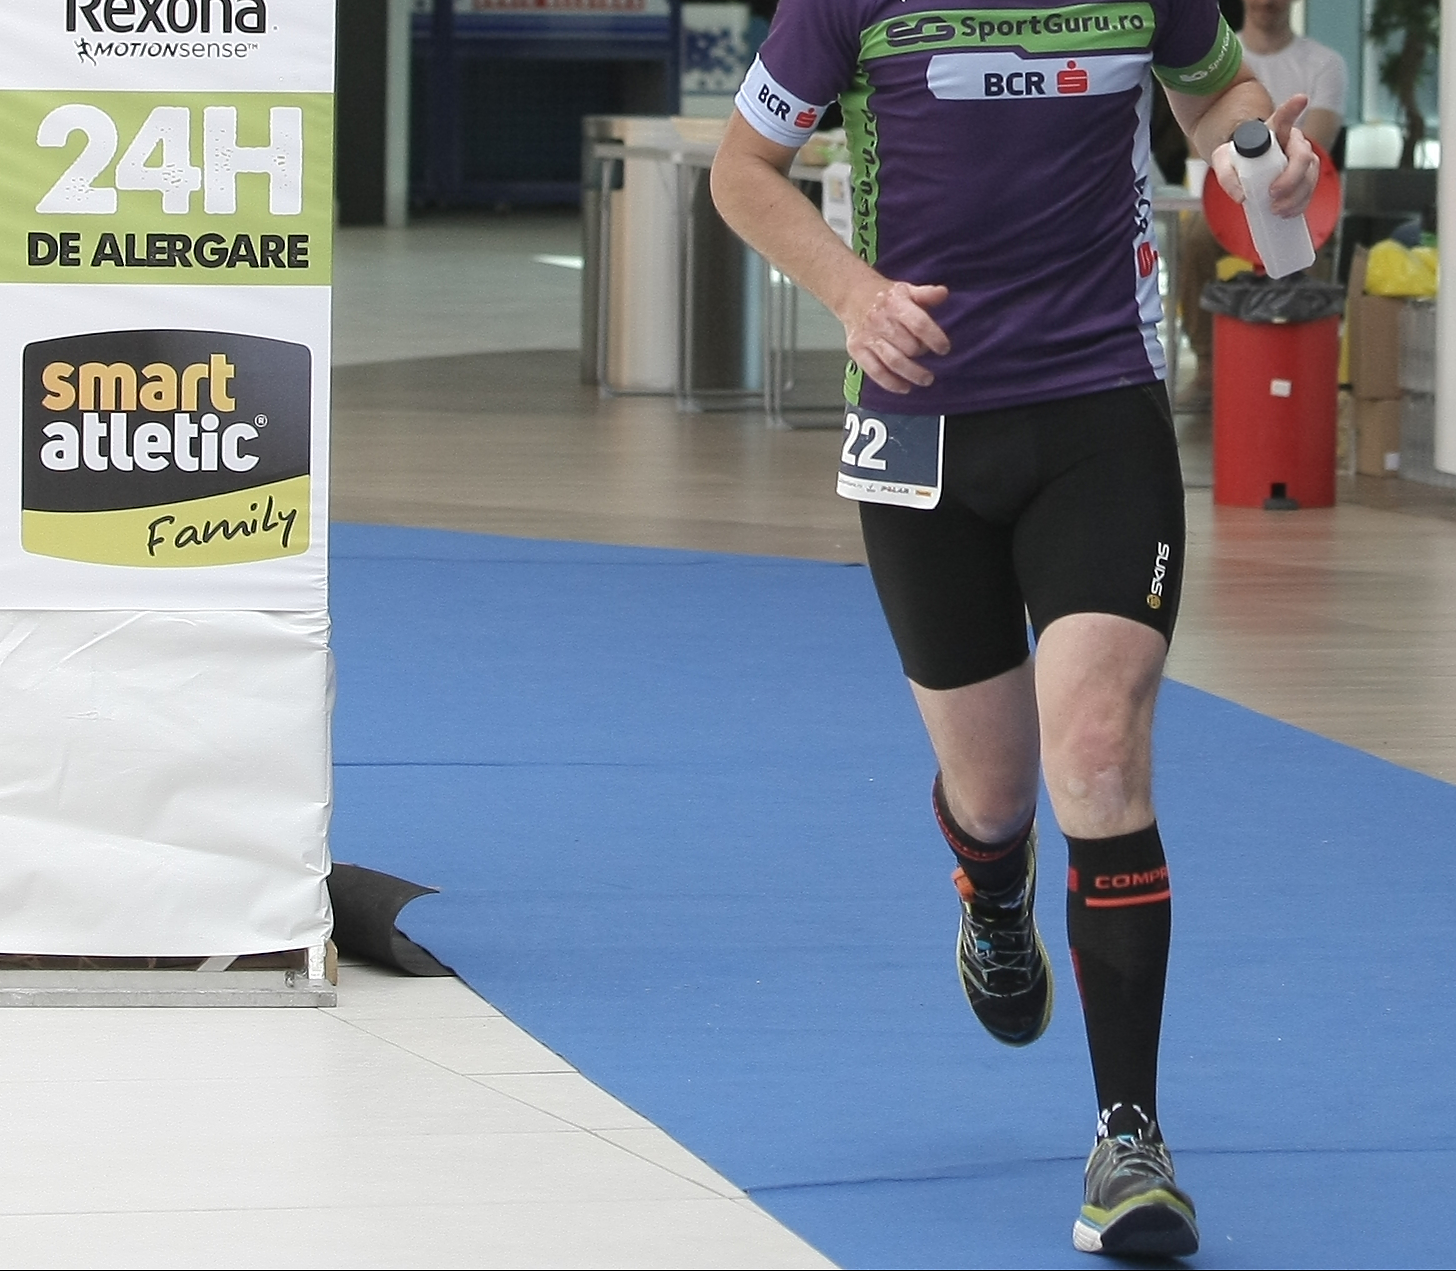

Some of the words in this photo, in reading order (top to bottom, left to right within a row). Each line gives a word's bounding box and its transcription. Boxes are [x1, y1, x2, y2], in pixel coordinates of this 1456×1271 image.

[961, 13, 1145, 43] SportGuru.ro
[757, 83, 791, 122] BCR
[984, 72, 1046, 97] BCR
[35, 103, 303, 215] 24H
[28, 232, 80, 266] DE
[91, 232, 309, 269] ALERGARE
[41, 353, 236, 413] smart
[147, 495, 299, 558] Family
[1150, 541, 1170, 597] SKINS
